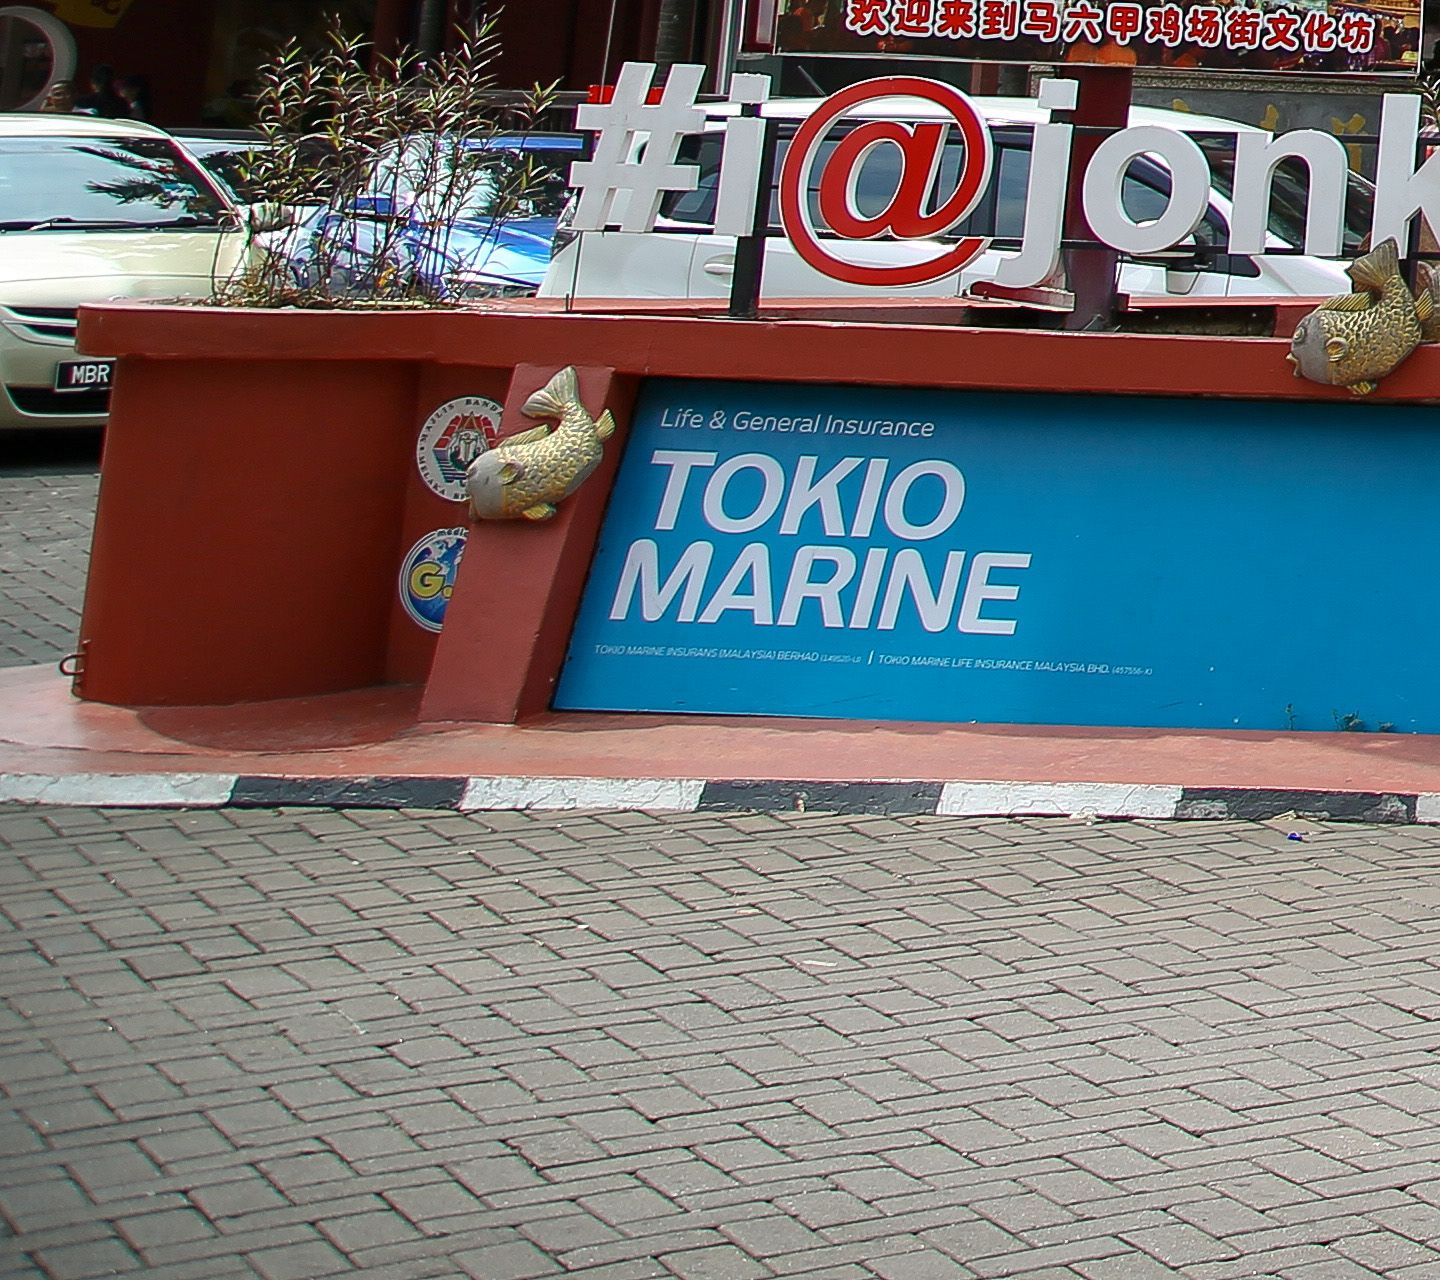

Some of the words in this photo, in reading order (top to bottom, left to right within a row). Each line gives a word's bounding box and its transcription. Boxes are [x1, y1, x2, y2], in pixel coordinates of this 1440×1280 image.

[70, 365, 110, 385] MBR
[660, 408, 704, 431] Life
[708, 411, 727, 431] &
[732, 411, 819, 435] General
[823, 414, 936, 439] Insurance
[650, 448, 968, 542] TOKIO
[608, 538, 1034, 637] MARINE
[594, 643, 626, 656] TOKIO
[625, 645, 666, 657] MARINE
[666, 647, 719, 659] INSURANS
[777, 650, 820, 662] BERHAD
[877, 653, 911, 666] TOKIO
[911, 655, 952, 668] MARINE
[951, 657, 974, 669] LIFE
[974, 658, 1034, 672] INSURANCE
[1034, 660, 1086, 674] MALAYSIA
